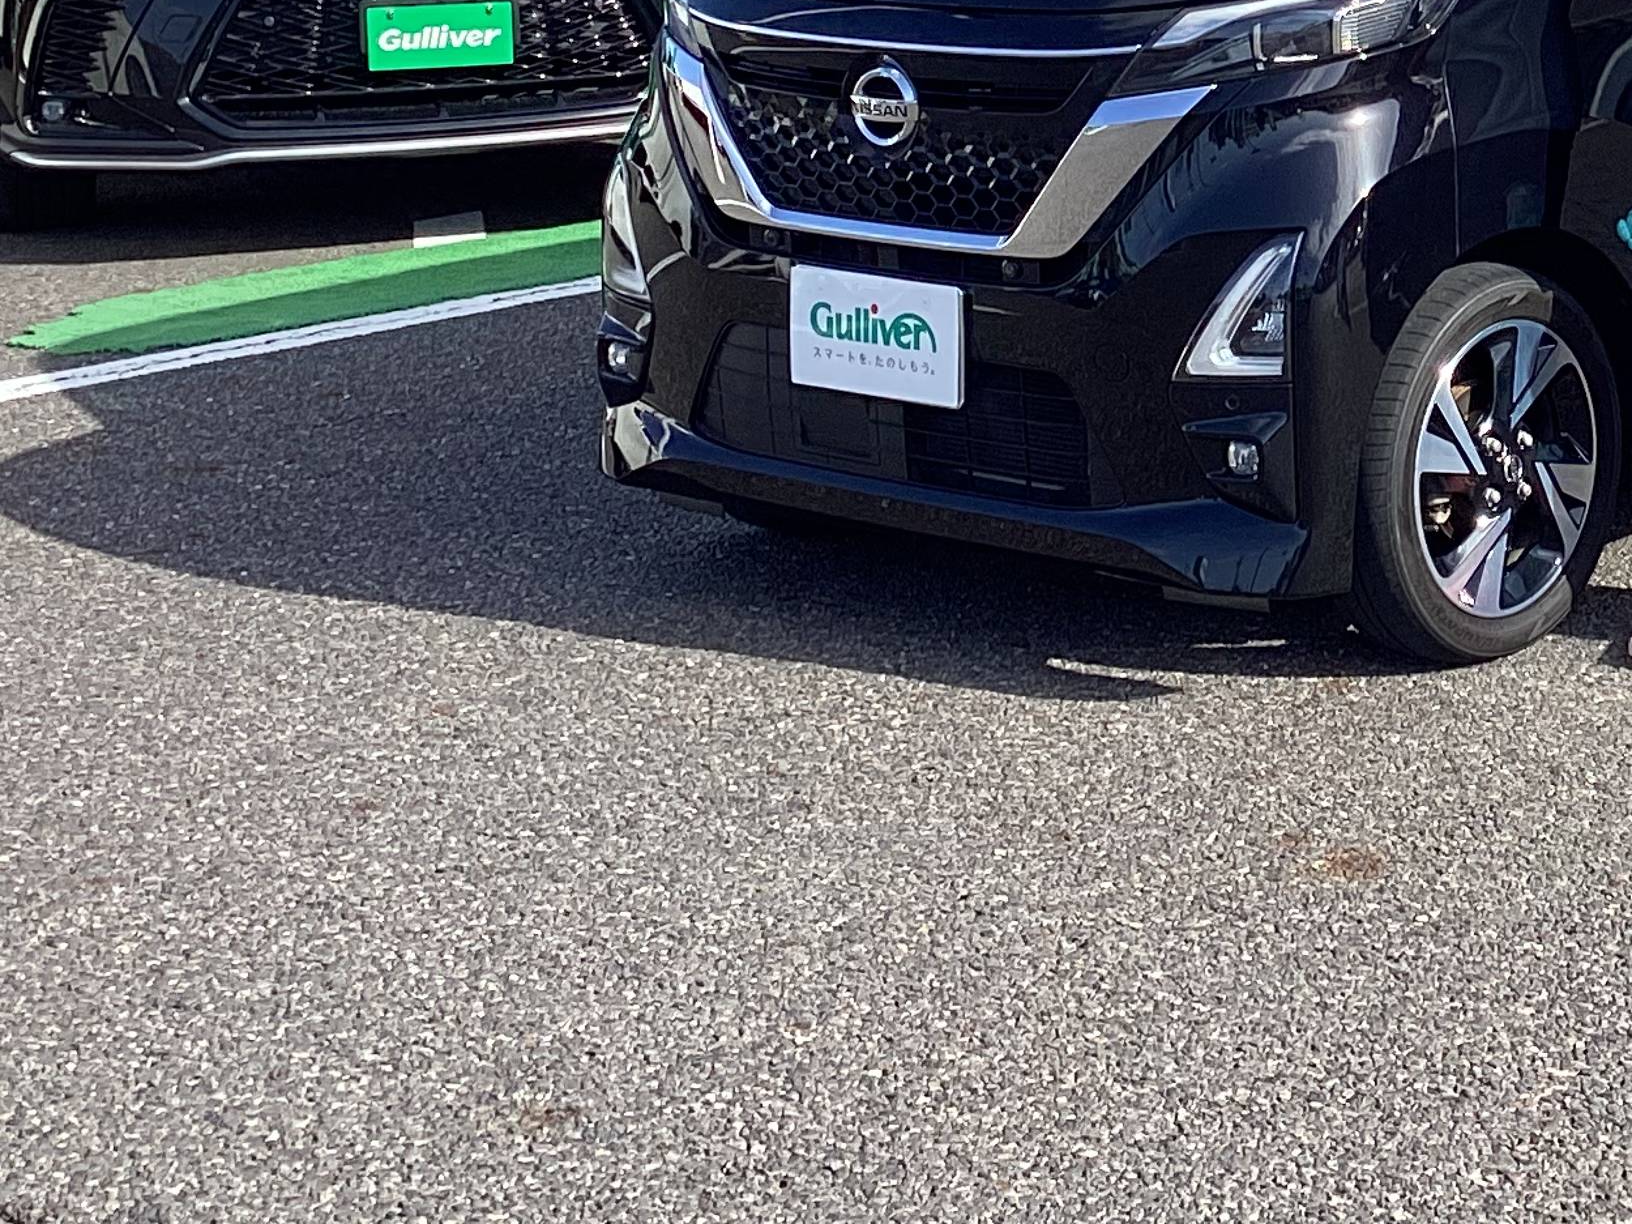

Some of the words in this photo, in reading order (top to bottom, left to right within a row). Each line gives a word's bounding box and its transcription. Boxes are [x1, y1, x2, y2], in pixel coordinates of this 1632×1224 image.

[377, 24, 502, 52] Gulliver
[850, 98, 909, 118] NISSAN
[809, 301, 938, 354] Gulliver
